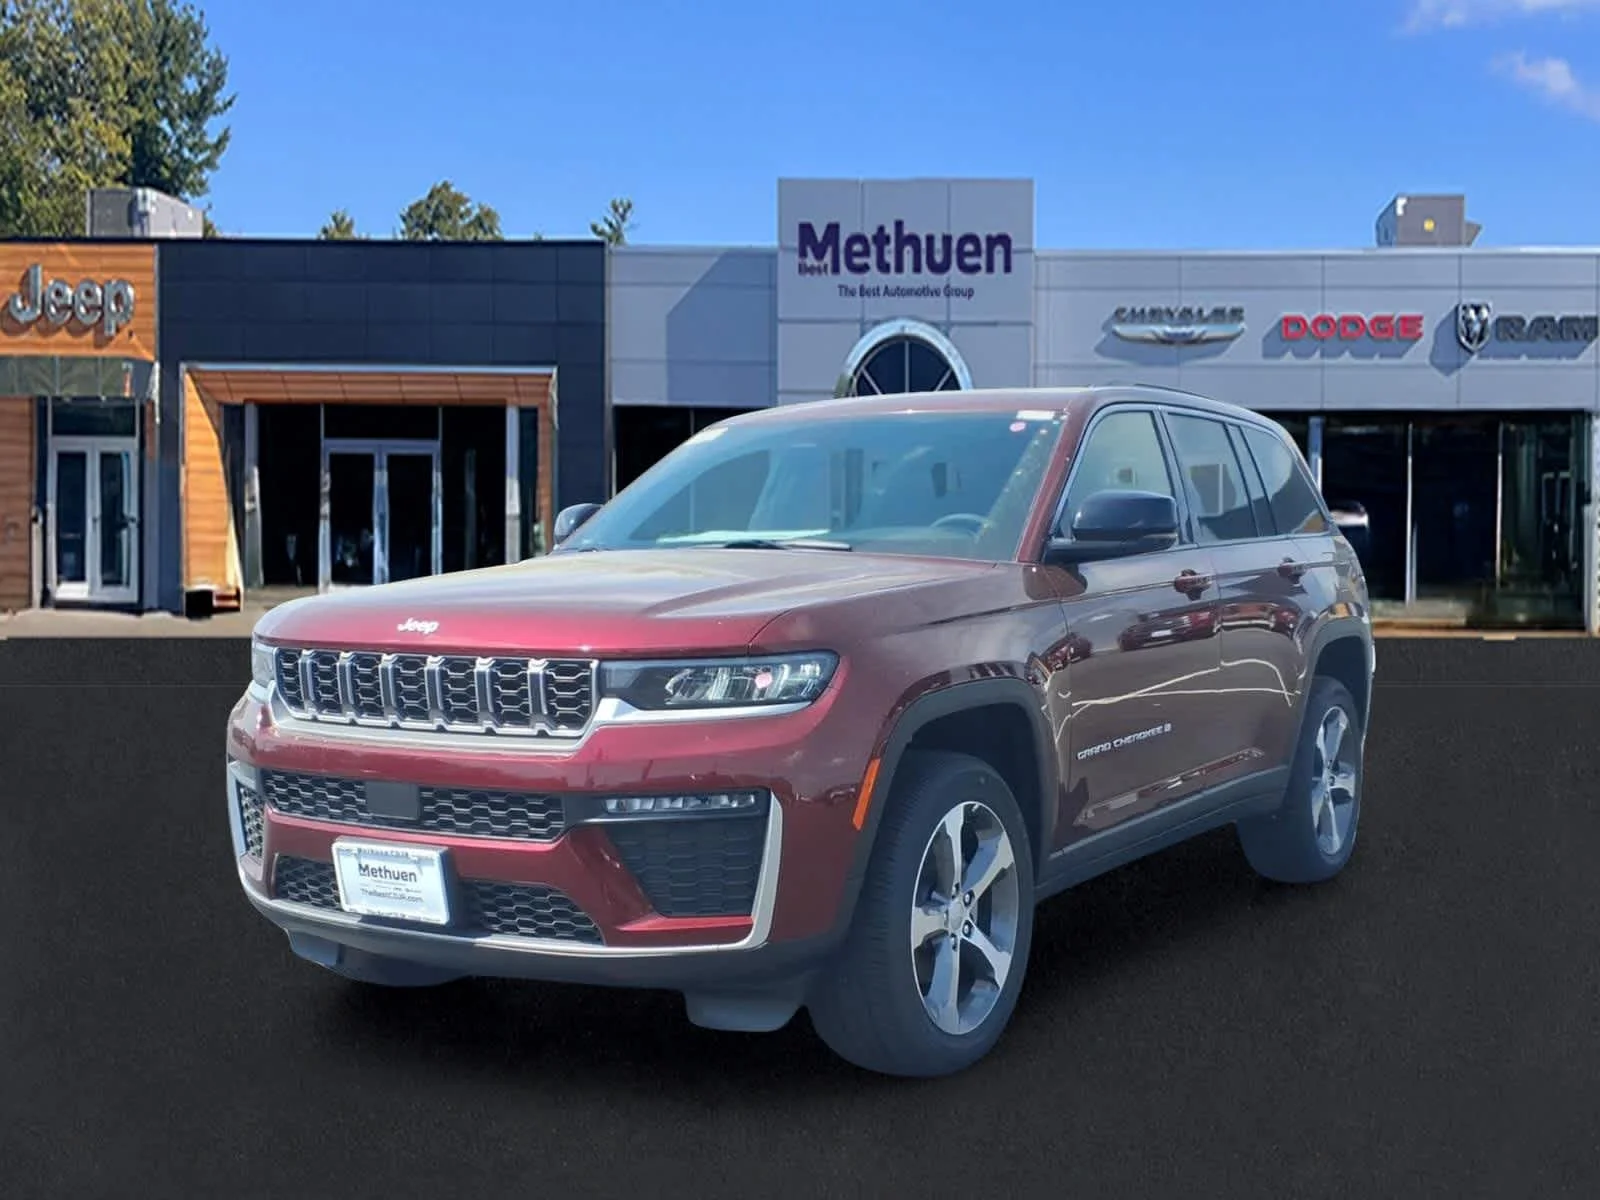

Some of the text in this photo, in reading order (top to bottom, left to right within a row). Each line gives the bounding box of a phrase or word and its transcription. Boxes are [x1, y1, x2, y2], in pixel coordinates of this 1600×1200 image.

[798, 219, 1012, 275] Methuen
[798, 262, 829, 276] Best
[9, 264, 135, 336] Jeep
[838, 283, 974, 300] The Best Automotive Group
[1114, 306, 1245, 323] CHRYSLER
[1281, 314, 1424, 340] DODGE
[1496, 316, 1599, 341] RAM
[397, 617, 439, 635] Jeep
[1077, 725, 1163, 760] GRAND CHEROKEE
[358, 863, 417, 882] Methuen
